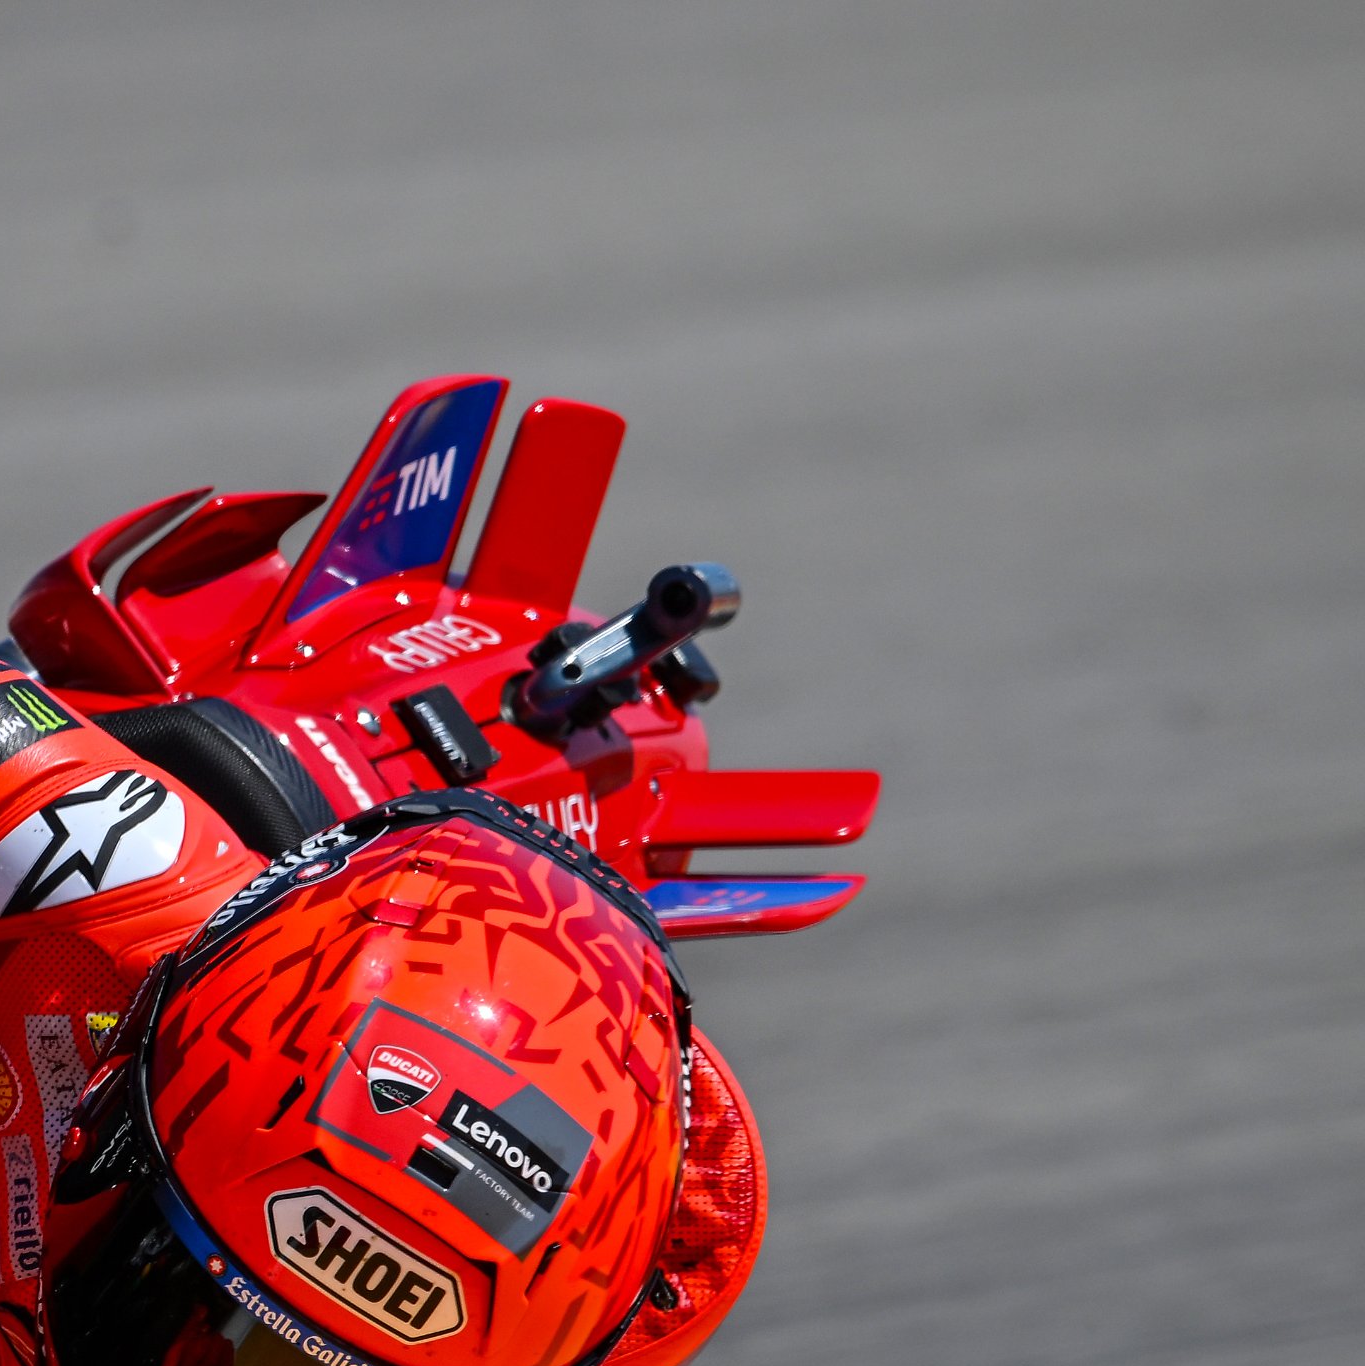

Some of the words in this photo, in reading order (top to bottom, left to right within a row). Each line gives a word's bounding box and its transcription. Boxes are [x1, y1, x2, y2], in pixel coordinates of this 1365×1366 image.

[393, 446, 457, 515] TIM
[295, 715, 376, 813] UCATI
[378, 1051, 433, 1083] DUCATI
[452, 1104, 553, 1193] Lenovo
[474, 1168, 511, 1202] FACTORY
[511, 1198, 536, 1222] TEAM
[286, 1206, 446, 1330] SHOEI
[224, 1276, 302, 1344] Estrella
